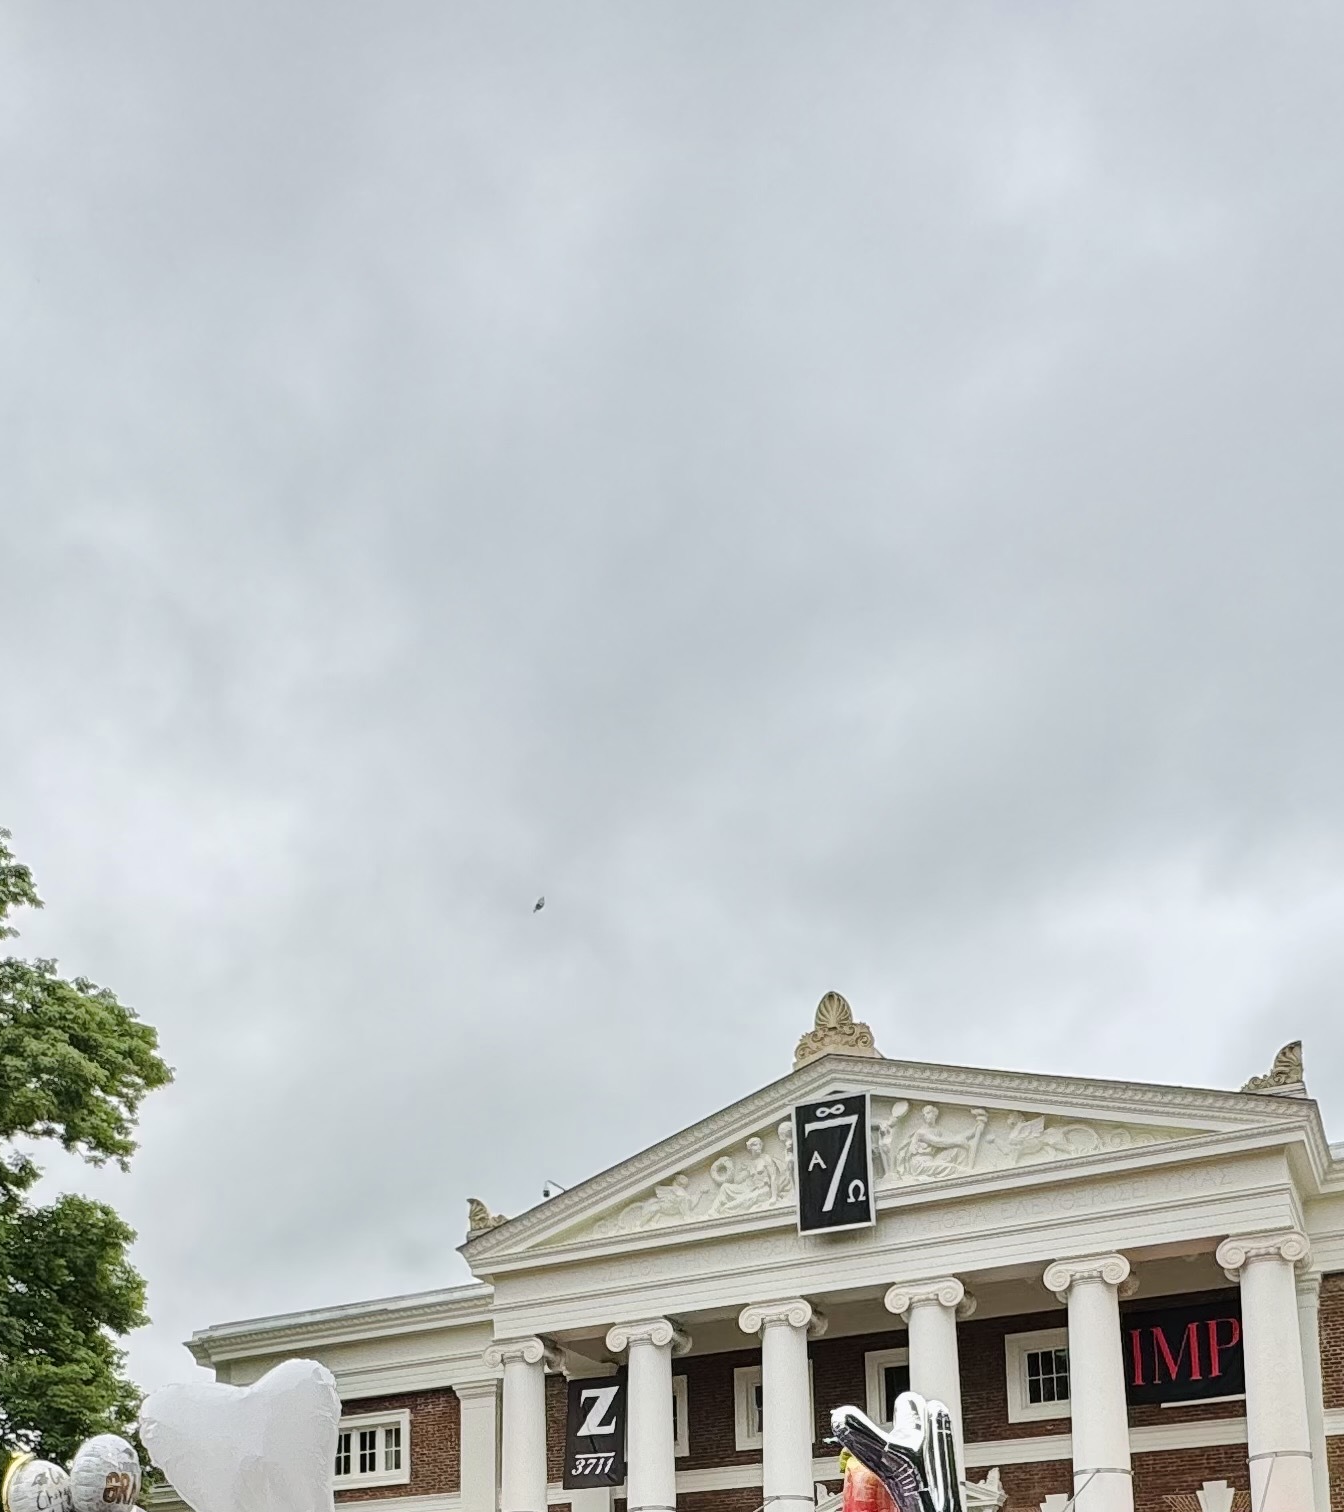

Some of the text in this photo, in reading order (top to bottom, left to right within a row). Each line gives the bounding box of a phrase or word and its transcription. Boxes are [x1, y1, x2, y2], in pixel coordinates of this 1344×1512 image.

[804, 1114, 858, 1212] 7
[1130, 1318, 1240, 1386] IMP
[577, 1386, 620, 1436] Z
[571, 1457, 614, 1475] 3711
